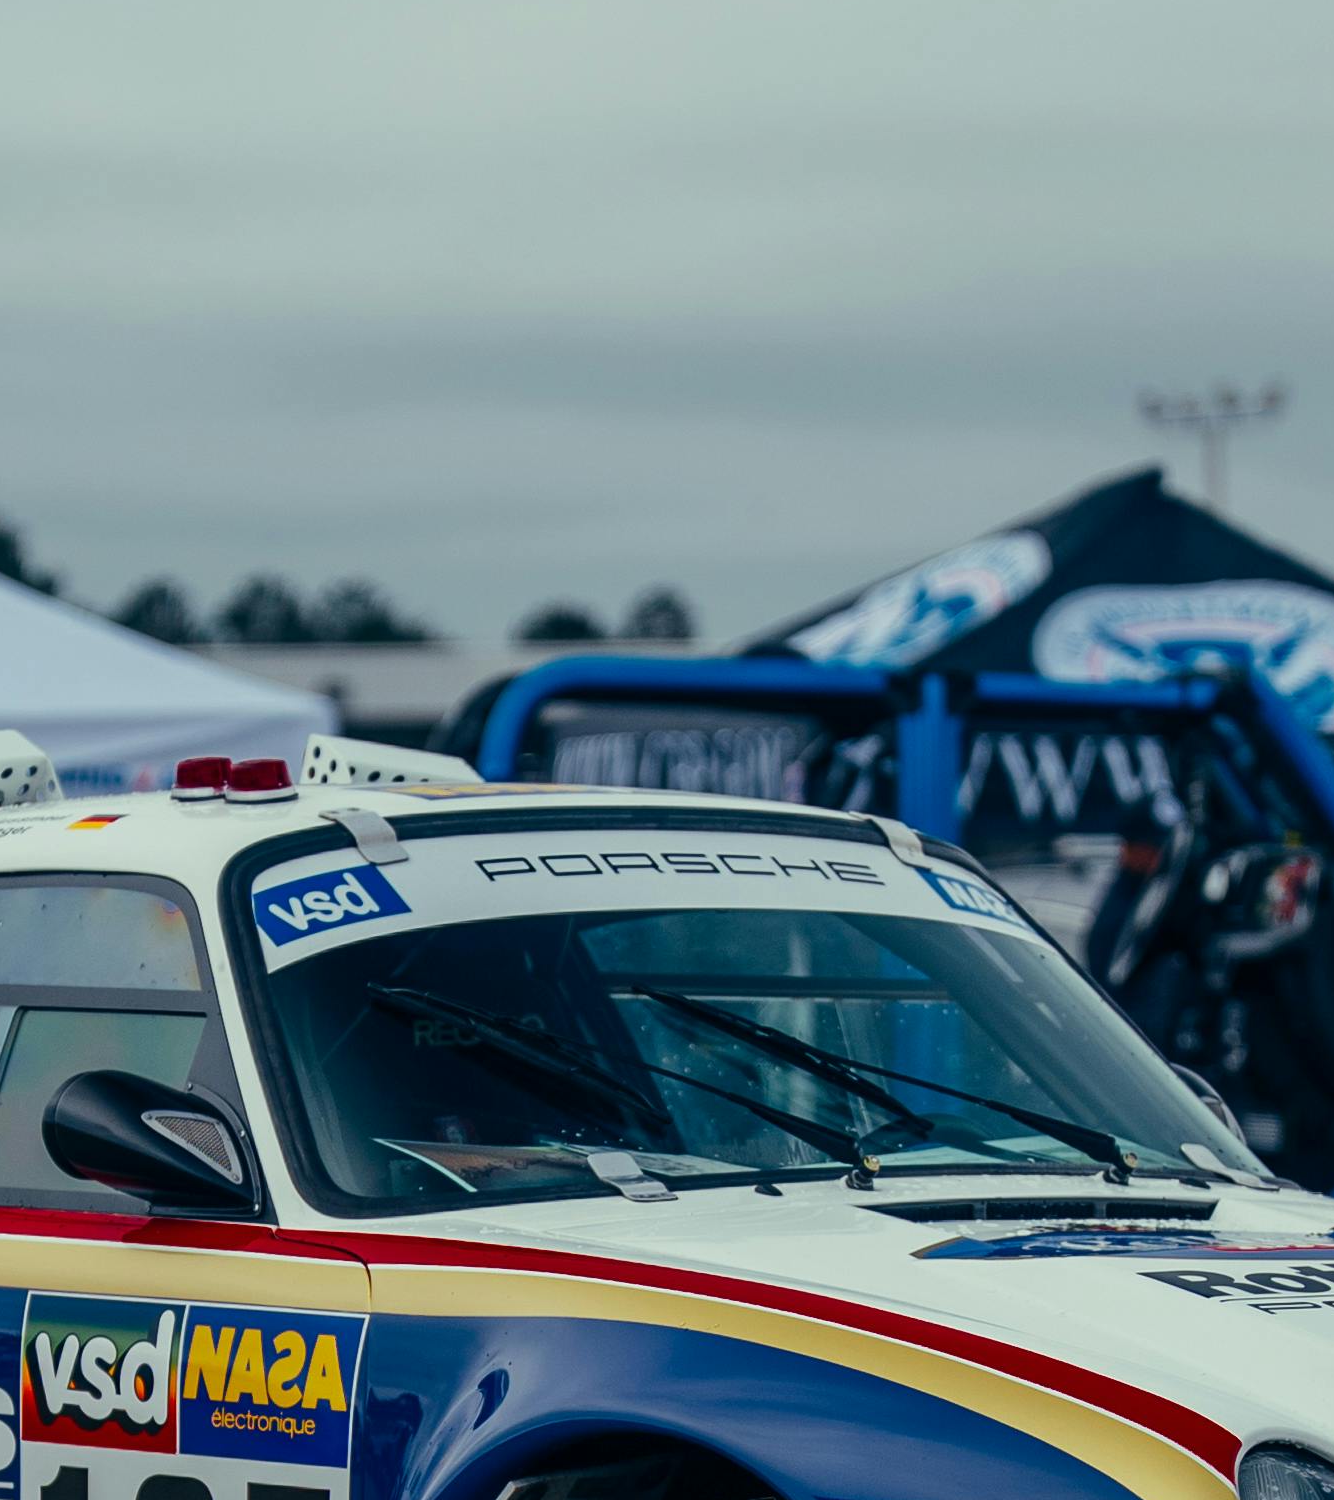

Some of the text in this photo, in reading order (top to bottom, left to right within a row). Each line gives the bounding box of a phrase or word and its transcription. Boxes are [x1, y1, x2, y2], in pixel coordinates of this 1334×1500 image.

[475, 852, 885, 887] PORSCHE
[268, 872, 380, 931] vsd
[34, 1309, 176, 1428] vsd
[210, 1409, 317, 1440] électronique
